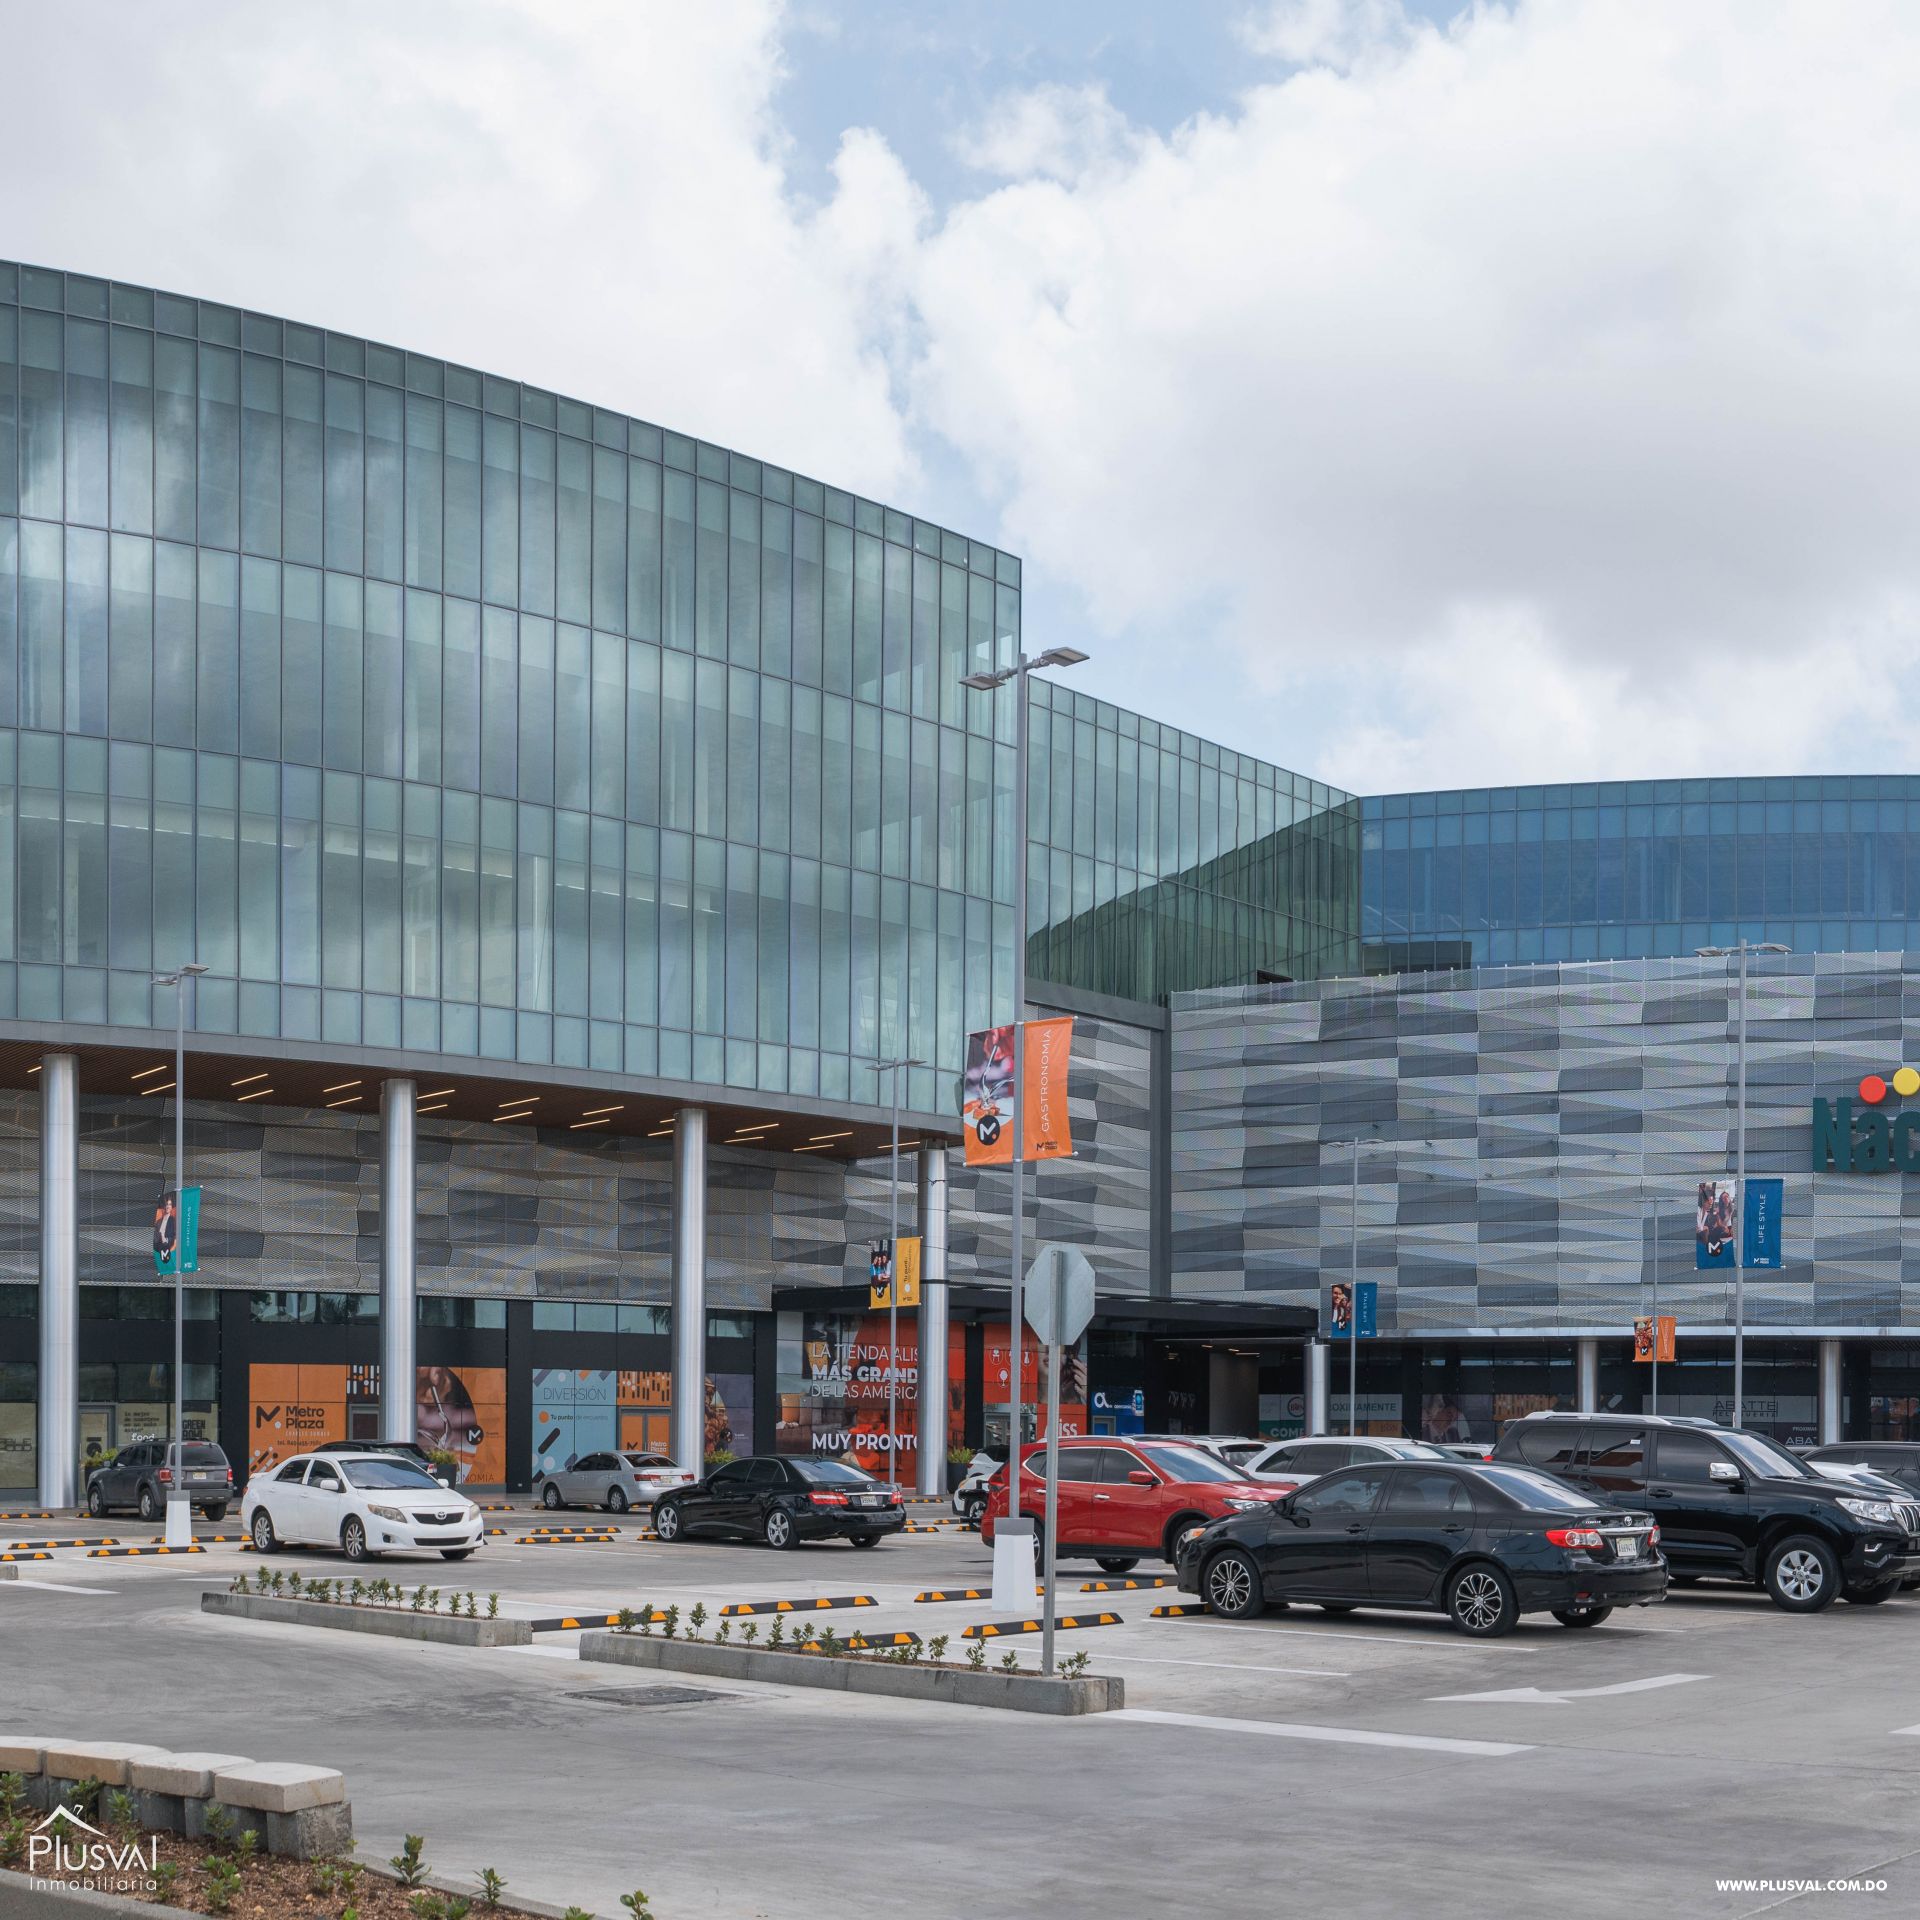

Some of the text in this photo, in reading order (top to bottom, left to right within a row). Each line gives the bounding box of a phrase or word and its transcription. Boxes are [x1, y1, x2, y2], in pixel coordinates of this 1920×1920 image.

[812, 1343, 831, 1358] LA
[834, 1344, 889, 1361] TIENDA
[812, 1360, 853, 1382] MÁS
[543, 1387, 607, 1401] DIVERSIÓN
[811, 1383, 831, 1397] DE
[834, 1384, 859, 1398] LAS
[286, 1405, 325, 1417] Metro
[286, 1418, 325, 1429] Plaza
[812, 1433, 851, 1450] MUY
